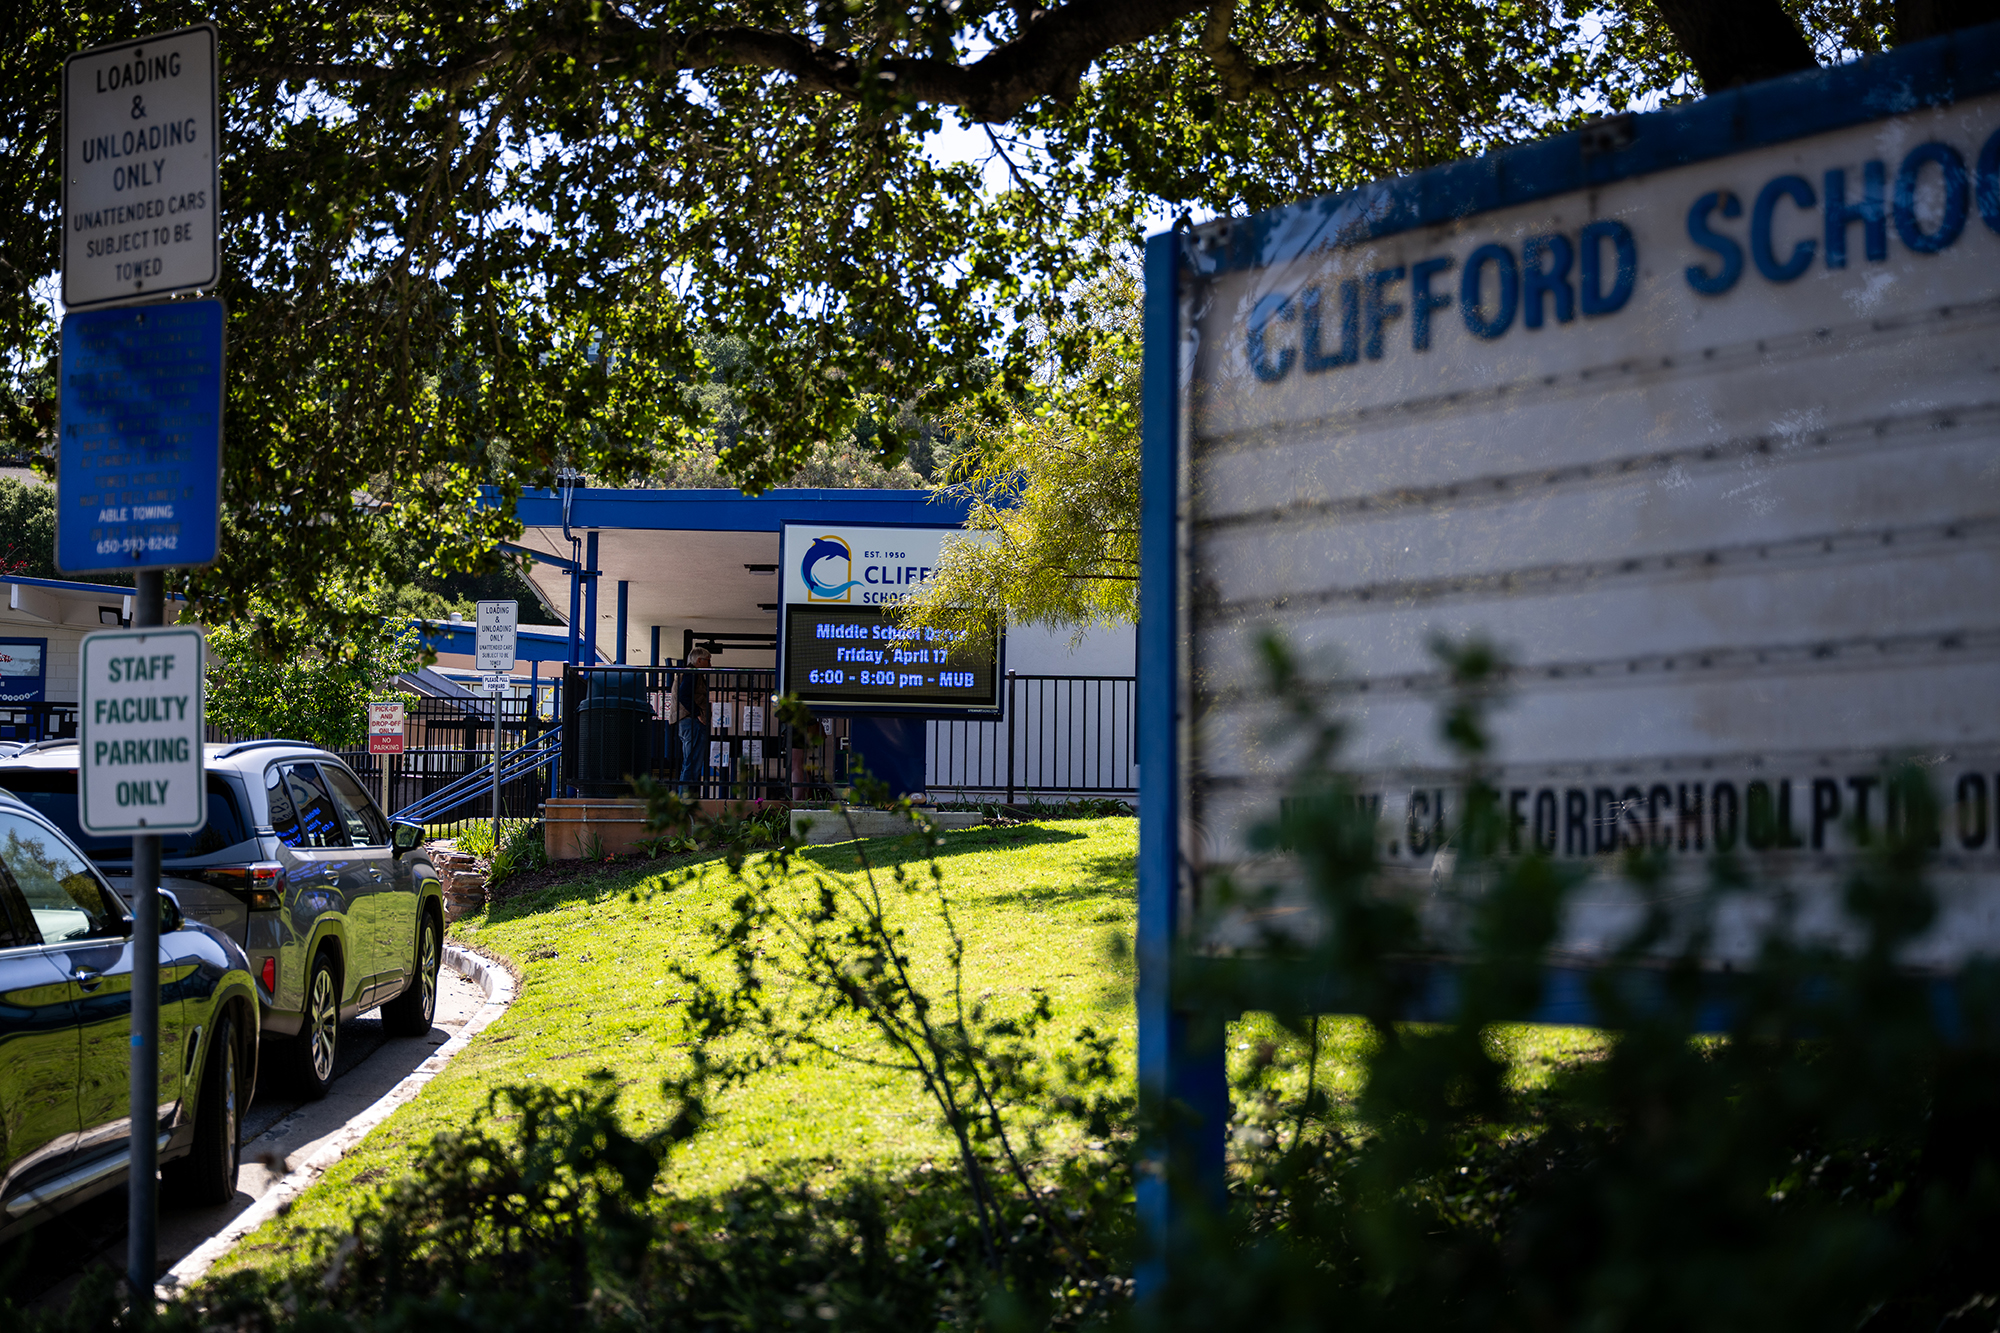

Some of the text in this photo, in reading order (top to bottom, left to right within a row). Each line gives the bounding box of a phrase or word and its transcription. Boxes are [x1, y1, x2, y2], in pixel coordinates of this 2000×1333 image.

[97, 52, 181, 93] LOADING
[131, 95, 147, 119] &
[83, 118, 196, 163] UNLOADING
[113, 159, 165, 191] ONLY
[74, 191, 206, 232] UNATTENDED CARS
[86, 222, 192, 258] SUBJECT TO BE
[115, 258, 162, 281] TOWED
[1246, 219, 1638, 383] CLIFFORD
[98, 505, 174, 522] ABLE TOWING
[885, 551, 906, 559] 1950
[485, 606, 510, 614] LOADING
[490, 634, 503, 642] ONLY
[816, 623, 869, 639] Middle
[872, 625, 921, 641] School
[108, 654, 175, 683] STAFF
[837, 647, 948, 666] Friday, April 17
[809, 669, 844, 685] 6:00
[860, 670, 895, 686] 8:00
[899, 672, 923, 689] pm
[939, 671, 975, 688] MUB
[94, 696, 188, 724] FACULTY
[95, 738, 189, 766] PARKING
[116, 780, 169, 807] ONLY
